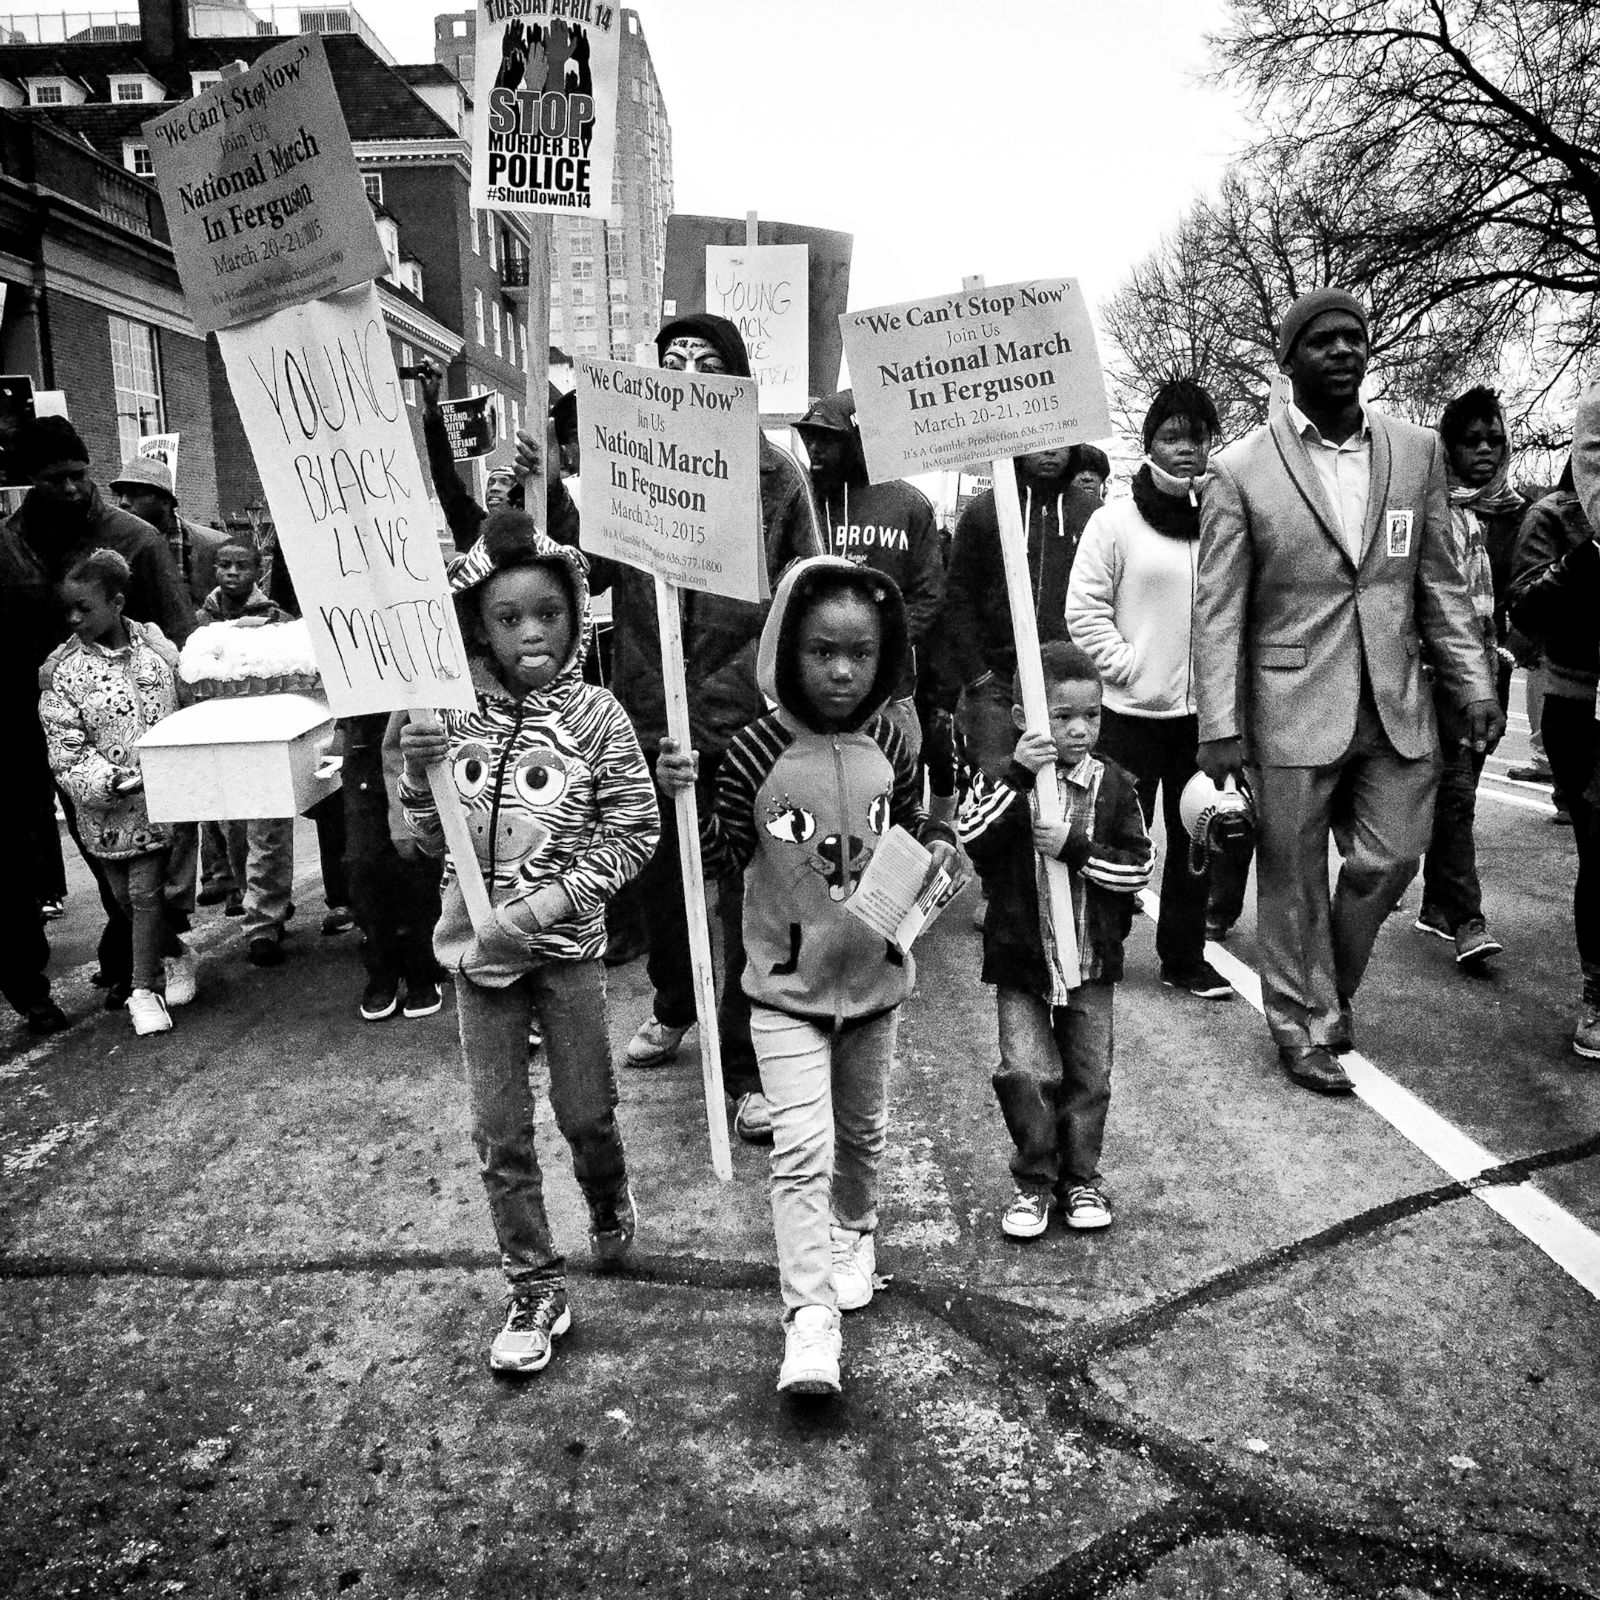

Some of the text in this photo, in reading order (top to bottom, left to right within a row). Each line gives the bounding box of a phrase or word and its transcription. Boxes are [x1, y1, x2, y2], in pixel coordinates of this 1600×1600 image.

[484, 0, 614, 32] TUESDAY APRIL 14
[188, 95, 230, 135] Can't
[488, 87, 595, 139] STOP
[218, 122, 270, 157] Join Us
[488, 133, 592, 158] MURDER BY
[178, 153, 267, 214] National
[488, 152, 591, 192] POLICE
[202, 183, 314, 244] In Ferguson
[487, 186, 592, 208] #ShutDownA14
[212, 244, 259, 276] March
[715, 271, 791, 315] YOUNG
[854, 283, 1070, 335] “We Can't Stop Now”
[723, 315, 773, 339] ACK
[947, 322, 1000, 347] Join Us
[747, 341, 770, 360] VE
[877, 331, 1072, 387] National March
[248, 319, 399, 444] YOUNG
[582, 363, 609, 390] “We
[645, 376, 684, 411] Stop
[689, 382, 744, 412] Now”
[907, 369, 1056, 411] In Ferguson
[442, 404, 455, 414] WE
[443, 412, 467, 423] STAND
[444, 421, 465, 432] WITH
[651, 413, 665, 432] Us
[914, 395, 1060, 436] March 20-21, 2015
[453, 448, 468, 458] NES
[920, 446, 929, 457] A
[929, 440, 967, 456] Gamble
[968, 430, 1019, 449] Production
[1021, 417, 1078, 438] 636.577.1800
[610, 461, 628, 490] In
[657, 441, 729, 480] March
[294, 448, 411, 523] BLACK
[977, 477, 993, 487] MIK
[611, 498, 643, 525] March
[672, 520, 706, 544] 2015
[836, 525, 909, 551] BROWN
[333, 516, 428, 582] LIVE
